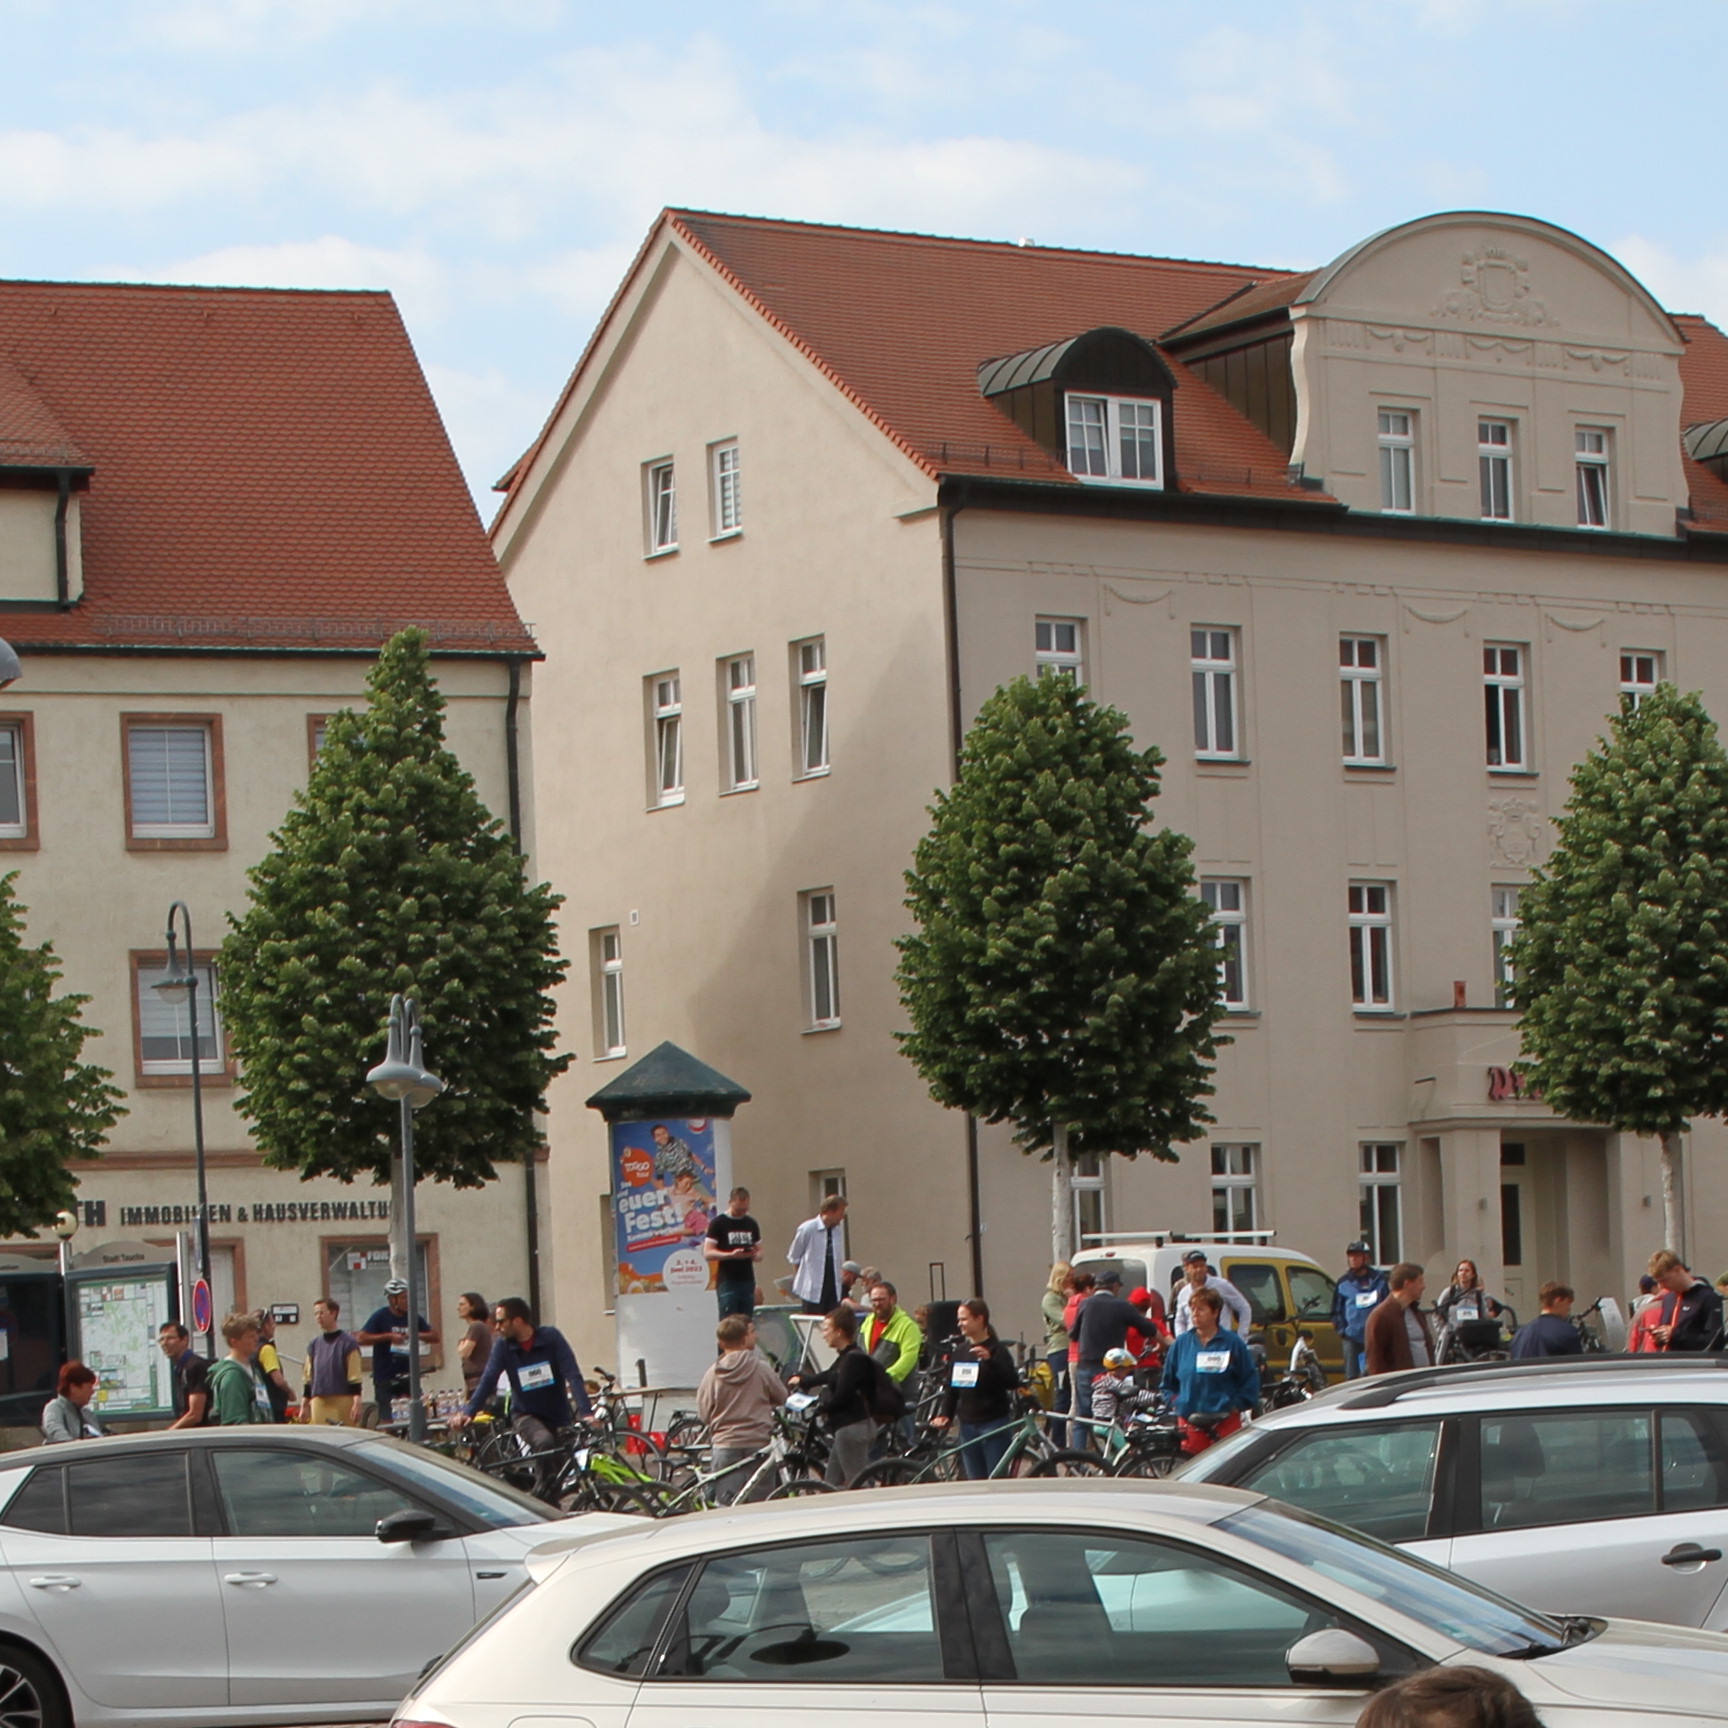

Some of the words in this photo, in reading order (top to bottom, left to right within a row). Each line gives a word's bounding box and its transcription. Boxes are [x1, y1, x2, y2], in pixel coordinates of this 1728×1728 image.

[120, 1203, 231, 1226] IMMOBIEN
[238, 1207, 248, 1222] &
[253, 1201, 390, 1222] HAUSVERWALTU
[619, 1190, 668, 1213] euer
[625, 1203, 684, 1233] Fest!
[367, 1252, 389, 1264] FOR
